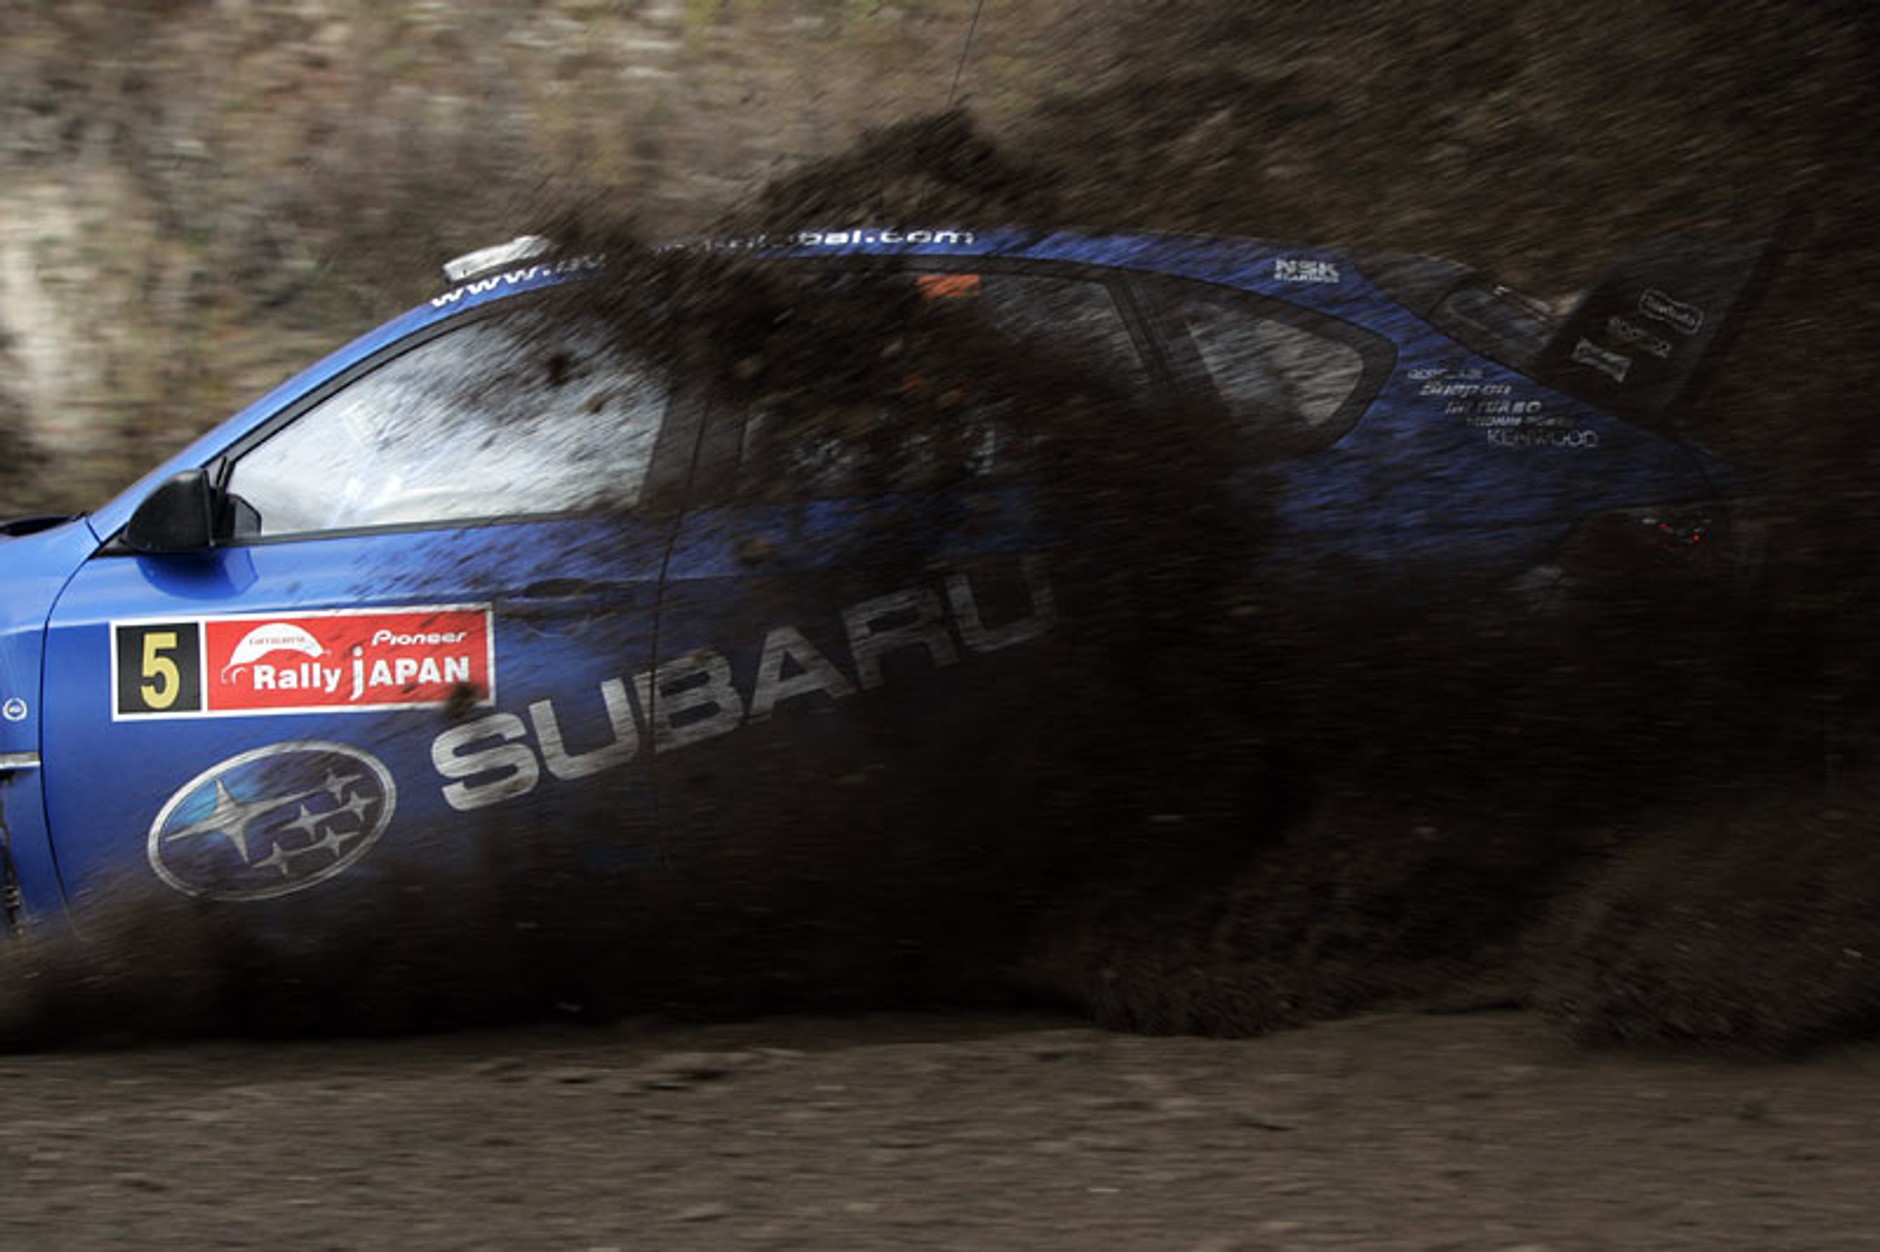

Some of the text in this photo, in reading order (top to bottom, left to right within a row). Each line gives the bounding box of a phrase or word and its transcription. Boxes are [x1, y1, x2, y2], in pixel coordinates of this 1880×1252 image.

[140, 632, 180, 709] 5
[253, 662, 342, 693] Rally
[431, 556, 1056, 813] SUBARU
